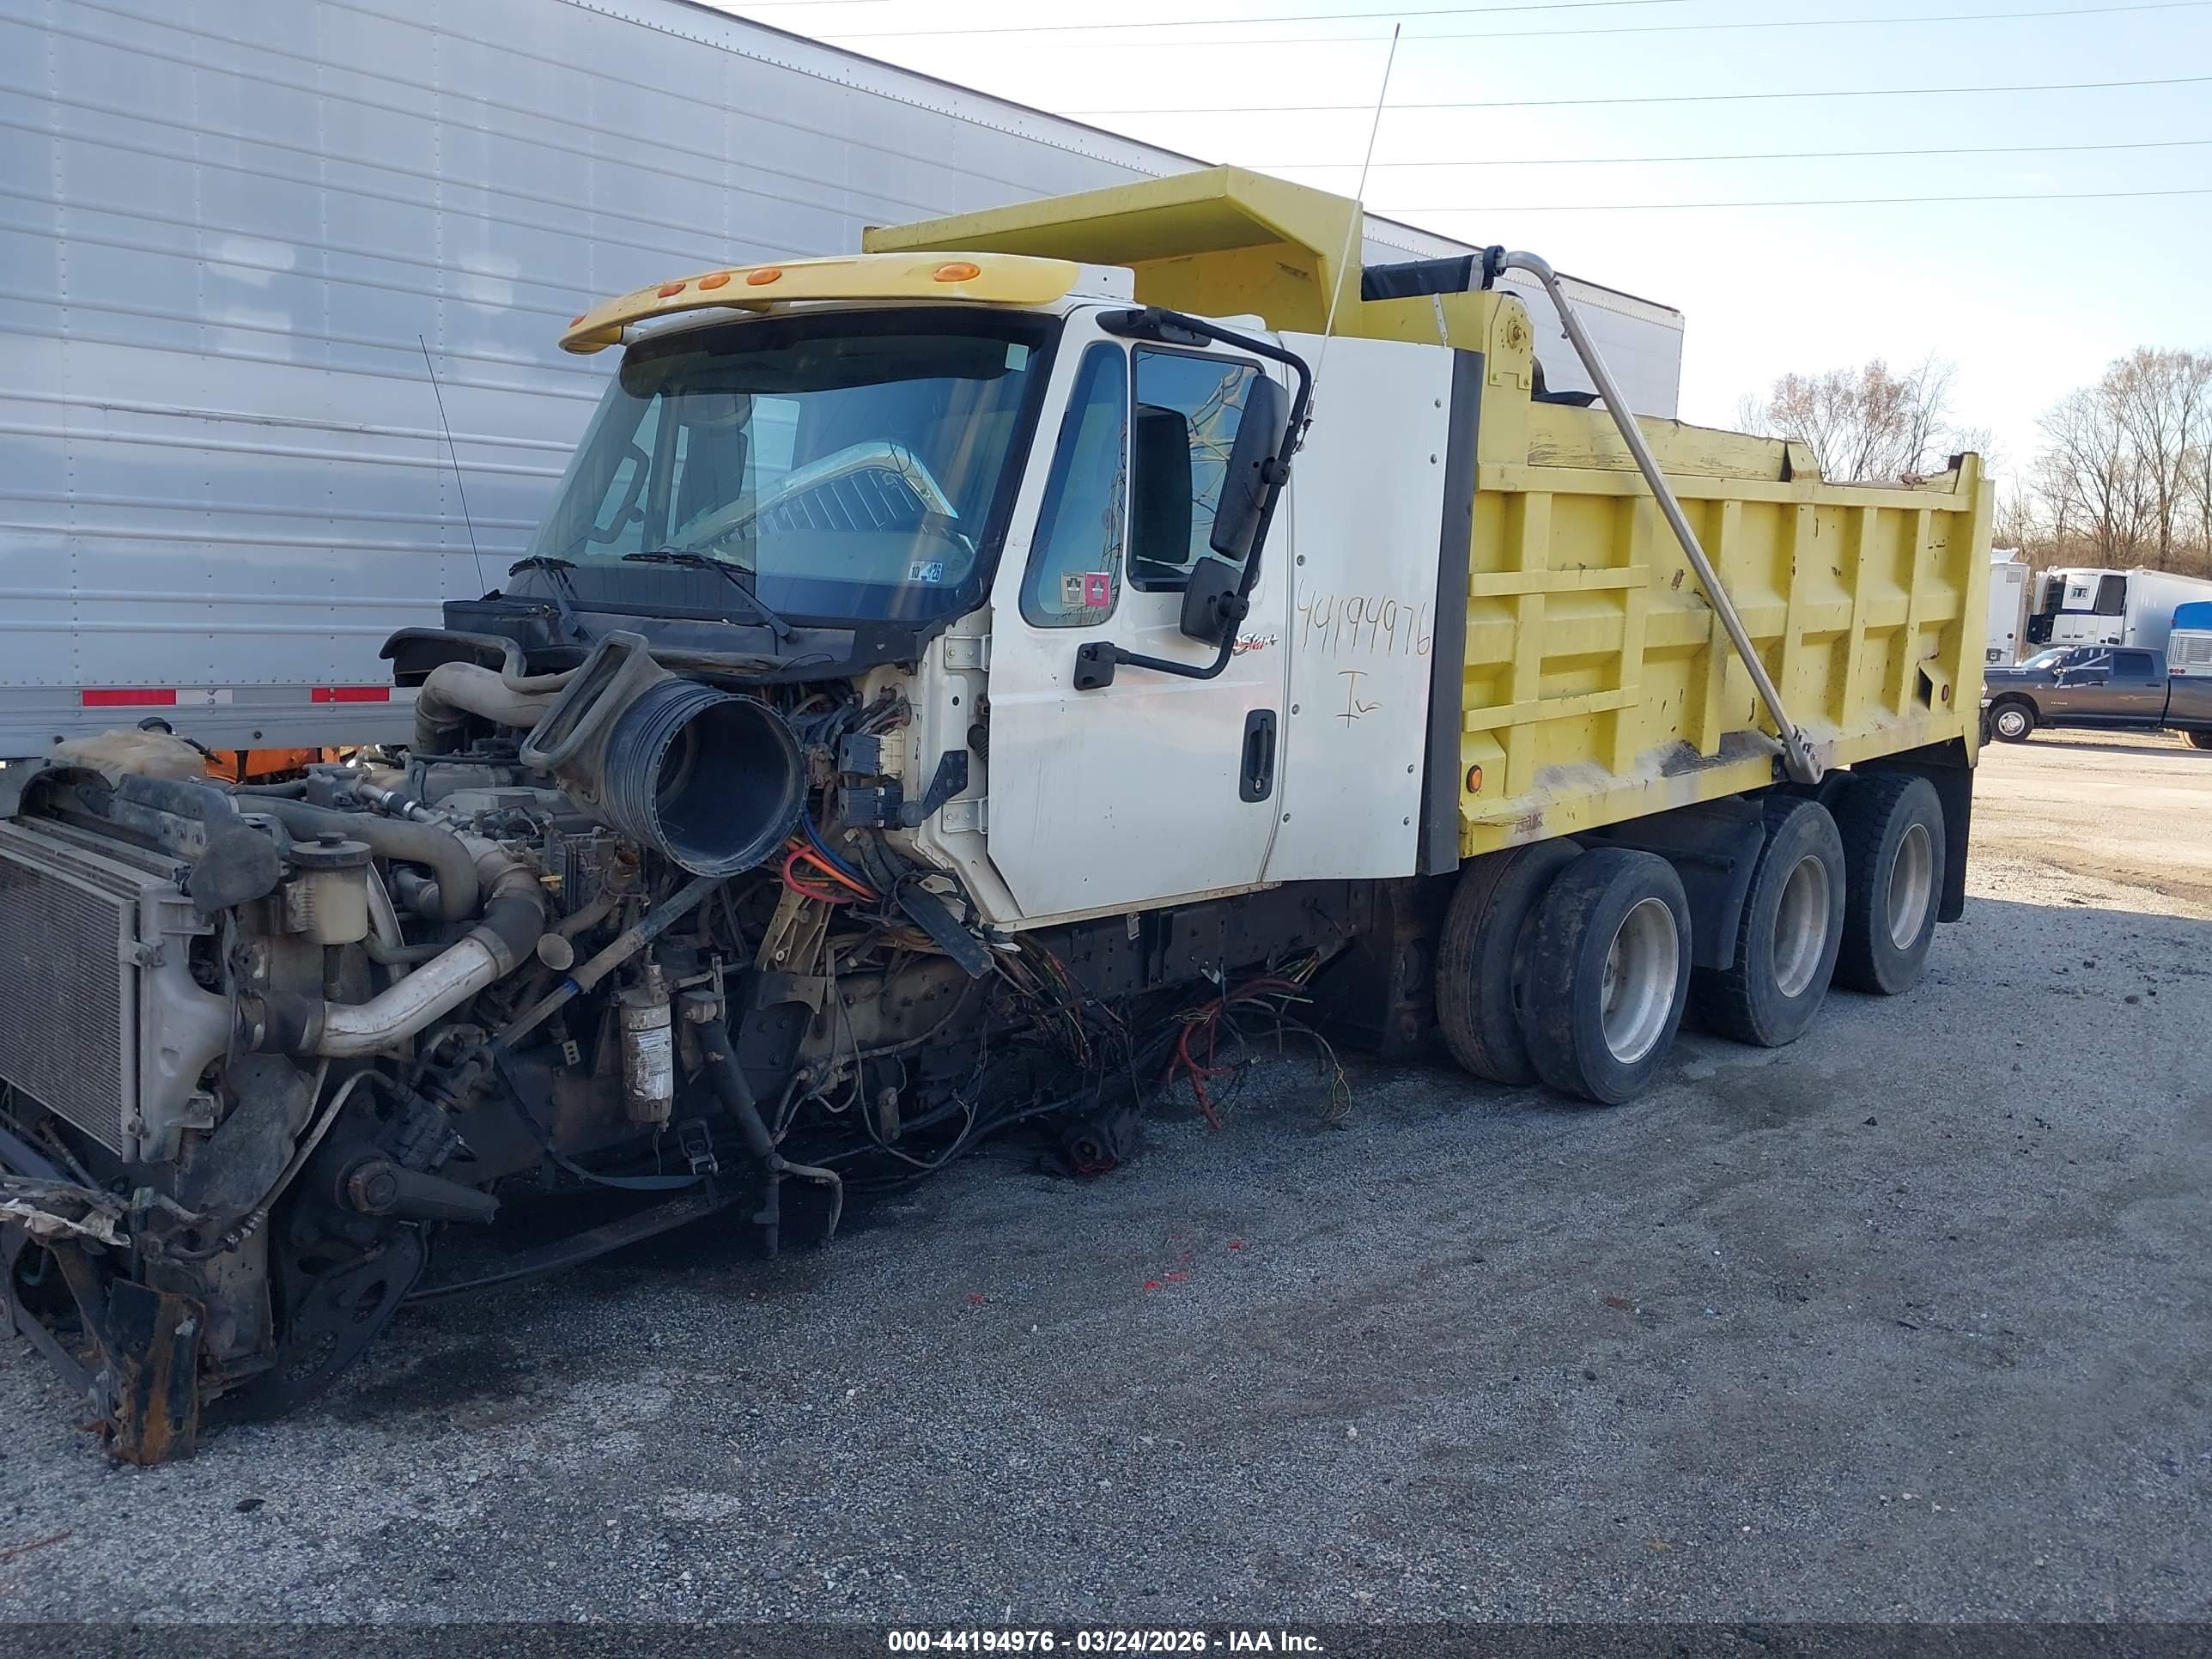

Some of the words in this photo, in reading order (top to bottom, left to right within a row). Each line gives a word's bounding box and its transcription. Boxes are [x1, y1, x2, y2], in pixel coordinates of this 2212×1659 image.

[911, 566, 921, 579] 10
[932, 564, 941, 580] 26
[1297, 578, 1431, 659] 44194976
